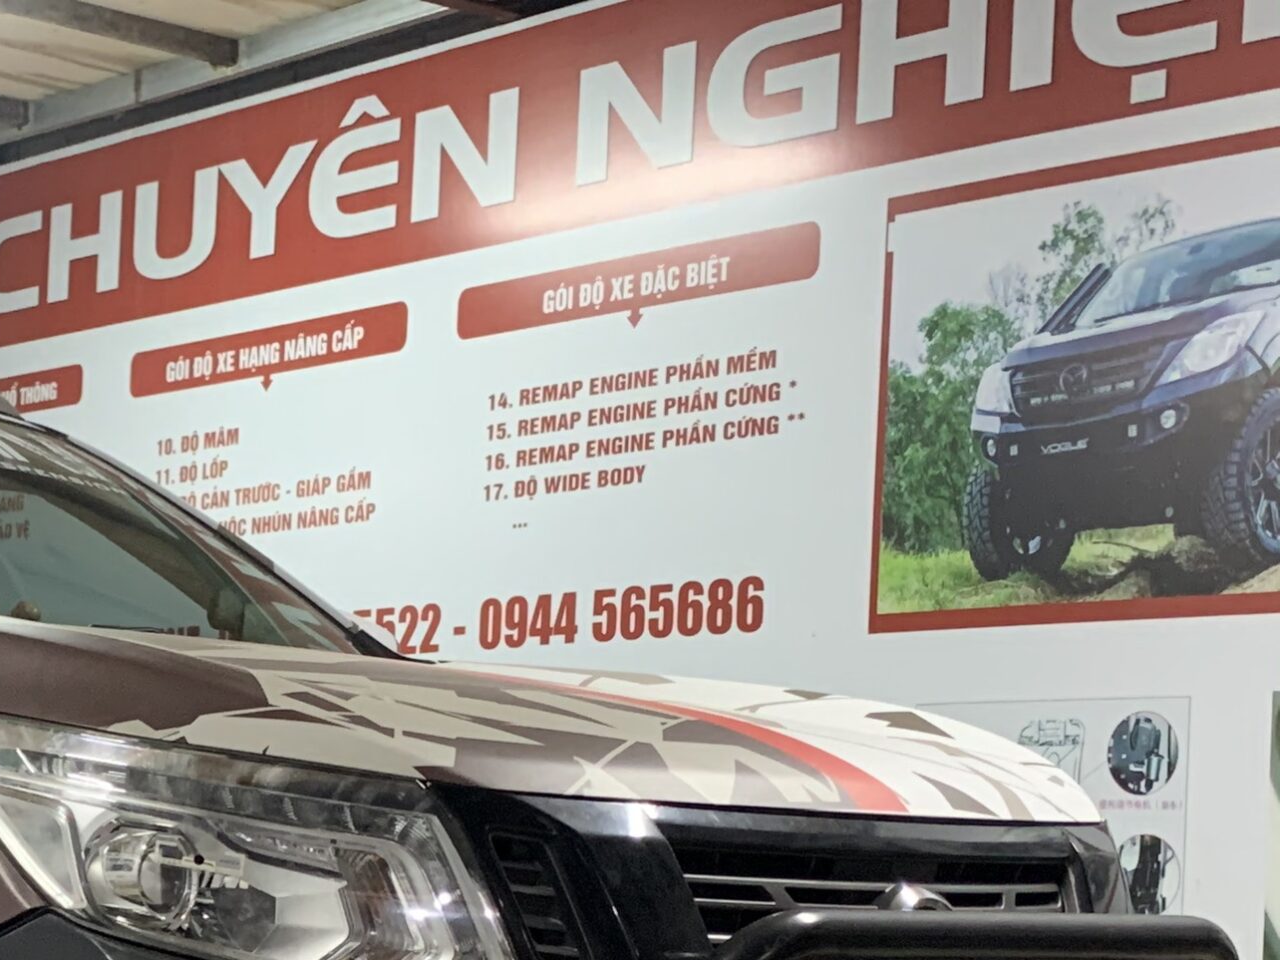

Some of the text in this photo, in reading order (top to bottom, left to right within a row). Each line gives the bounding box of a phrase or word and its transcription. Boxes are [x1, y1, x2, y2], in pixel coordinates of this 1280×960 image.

[576, 0, 1280, 187] NGHIỆ
[542, 254, 731, 314] GÓI ĐỘ XE ĐẶC BIỆT
[166, 319, 365, 383] GÓI ĐỘ XE HẠNG NÂNG CẤP
[486, 423, 511, 442] 15.
[517, 411, 582, 437] REMAP
[587, 399, 657, 427] ENGINE
[724, 382, 781, 408] CỨNG
[488, 392, 513, 412] 14.
[519, 380, 583, 406] REMAP
[589, 368, 660, 396] ENGINE
[157, 426, 239, 456] 10. ĐỘ MÂM
[485, 454, 510, 472] 16.
[515, 442, 580, 468] REMAP
[585, 431, 655, 459] ENGINE
[723, 415, 780, 441] CỨNG
[180, 460, 198, 485] ĐỘ
[235, 482, 281, 506] TRƯỚC
[296, 474, 331, 498] GIÁP
[483, 465, 646, 502] 17. ĐỘ WIDE BODY
[251, 510, 292, 535] NHÚN
[297, 506, 339, 530] NÂNG
[344, 497, 376, 524] CẤP
[353, 603, 442, 655] 522
[478, 591, 578, 650] 0944
[592, 575, 765, 643] 565686
